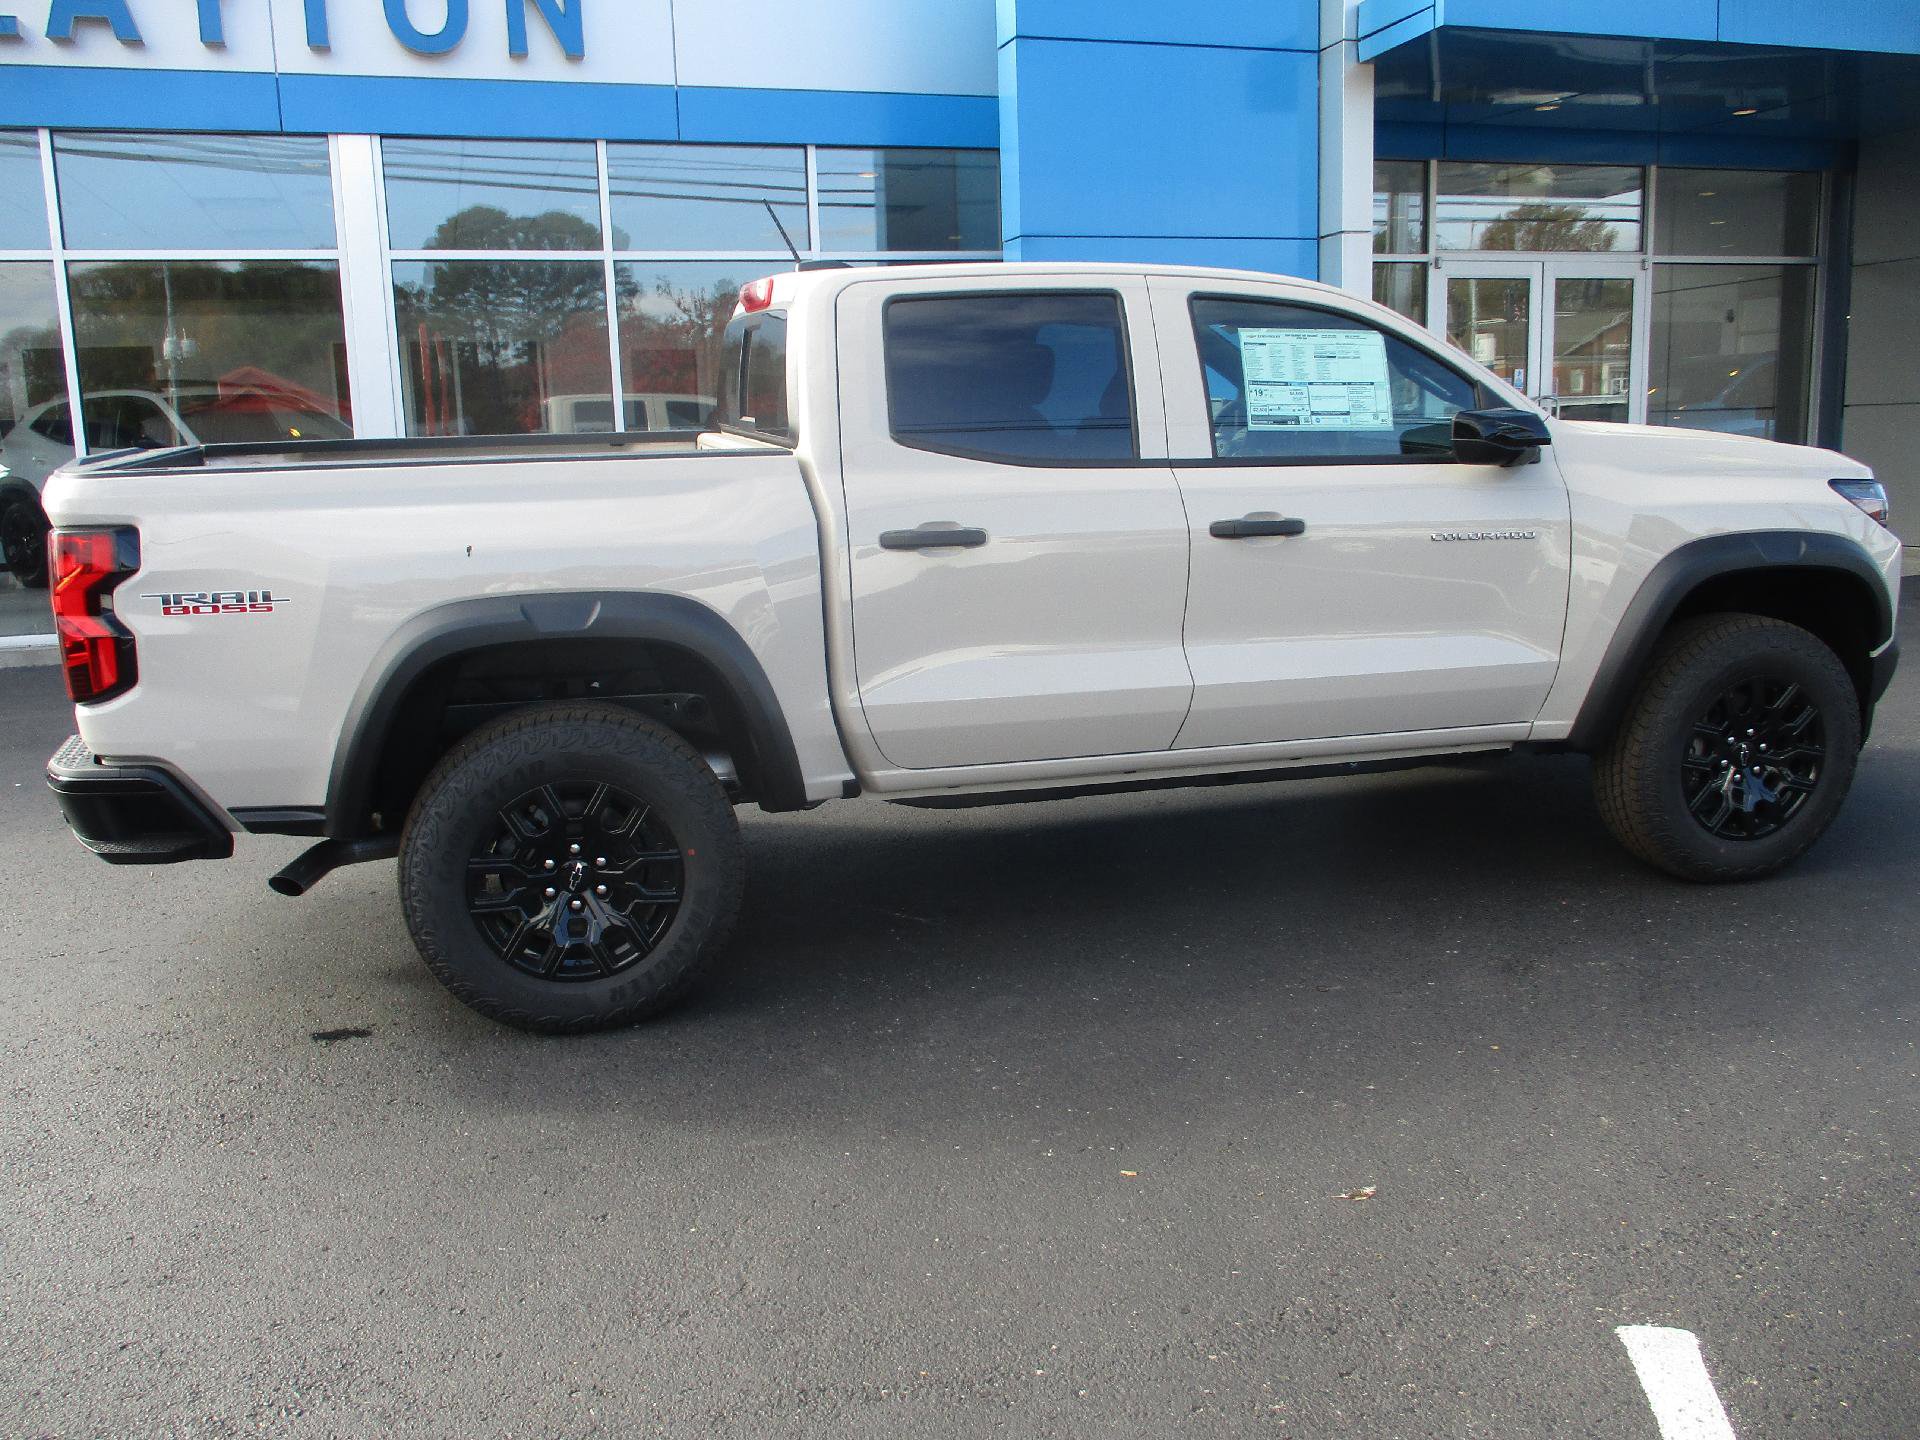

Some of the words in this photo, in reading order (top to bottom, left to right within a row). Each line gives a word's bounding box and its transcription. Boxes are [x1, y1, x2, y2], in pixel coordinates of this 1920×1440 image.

[0, 0, 585, 58] AON
[1430, 531, 1536, 542] COLORADO
[141, 589, 291, 606] TRAIL
[162, 602, 274, 616] BOSS
